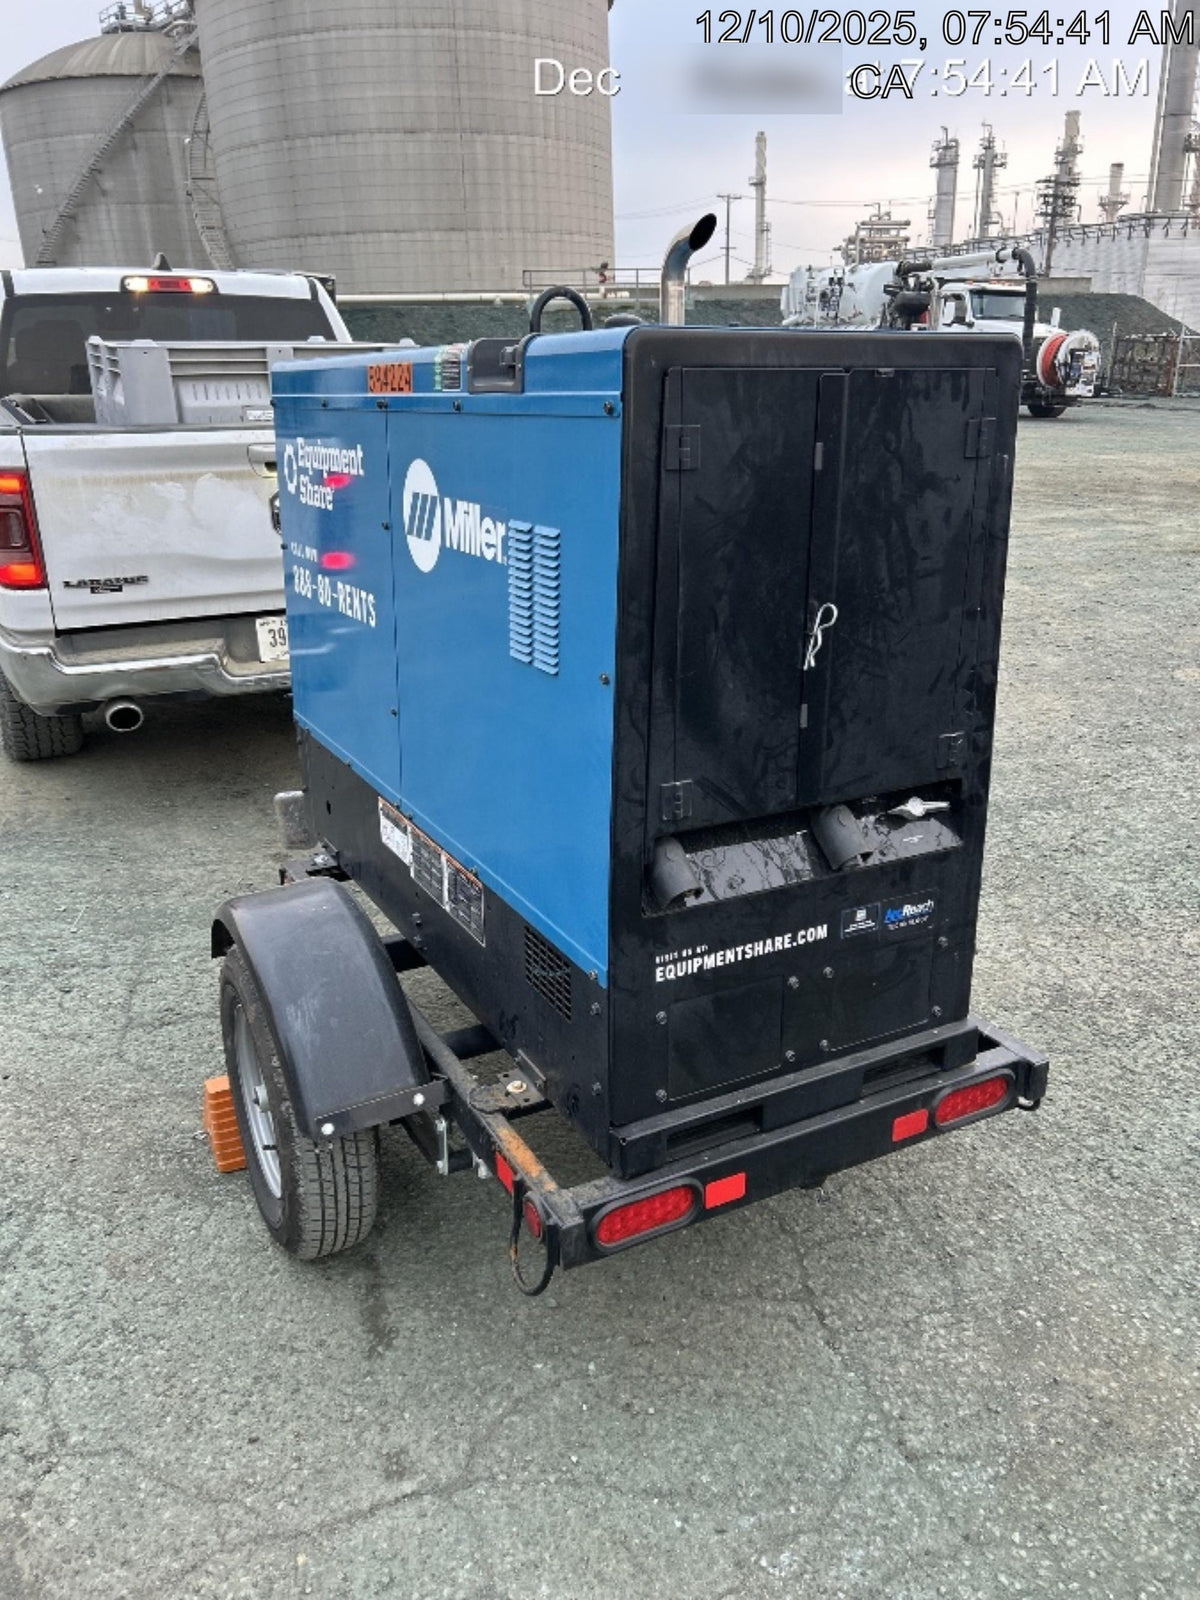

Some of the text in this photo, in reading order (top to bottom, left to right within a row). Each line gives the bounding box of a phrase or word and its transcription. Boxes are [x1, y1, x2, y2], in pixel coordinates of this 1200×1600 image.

[296, 437, 365, 479] Equipment
[299, 474, 334, 511] Share
[444, 497, 506, 565] Miller
[655, 924, 828, 982] EQUIPMENTSHARE.COM
